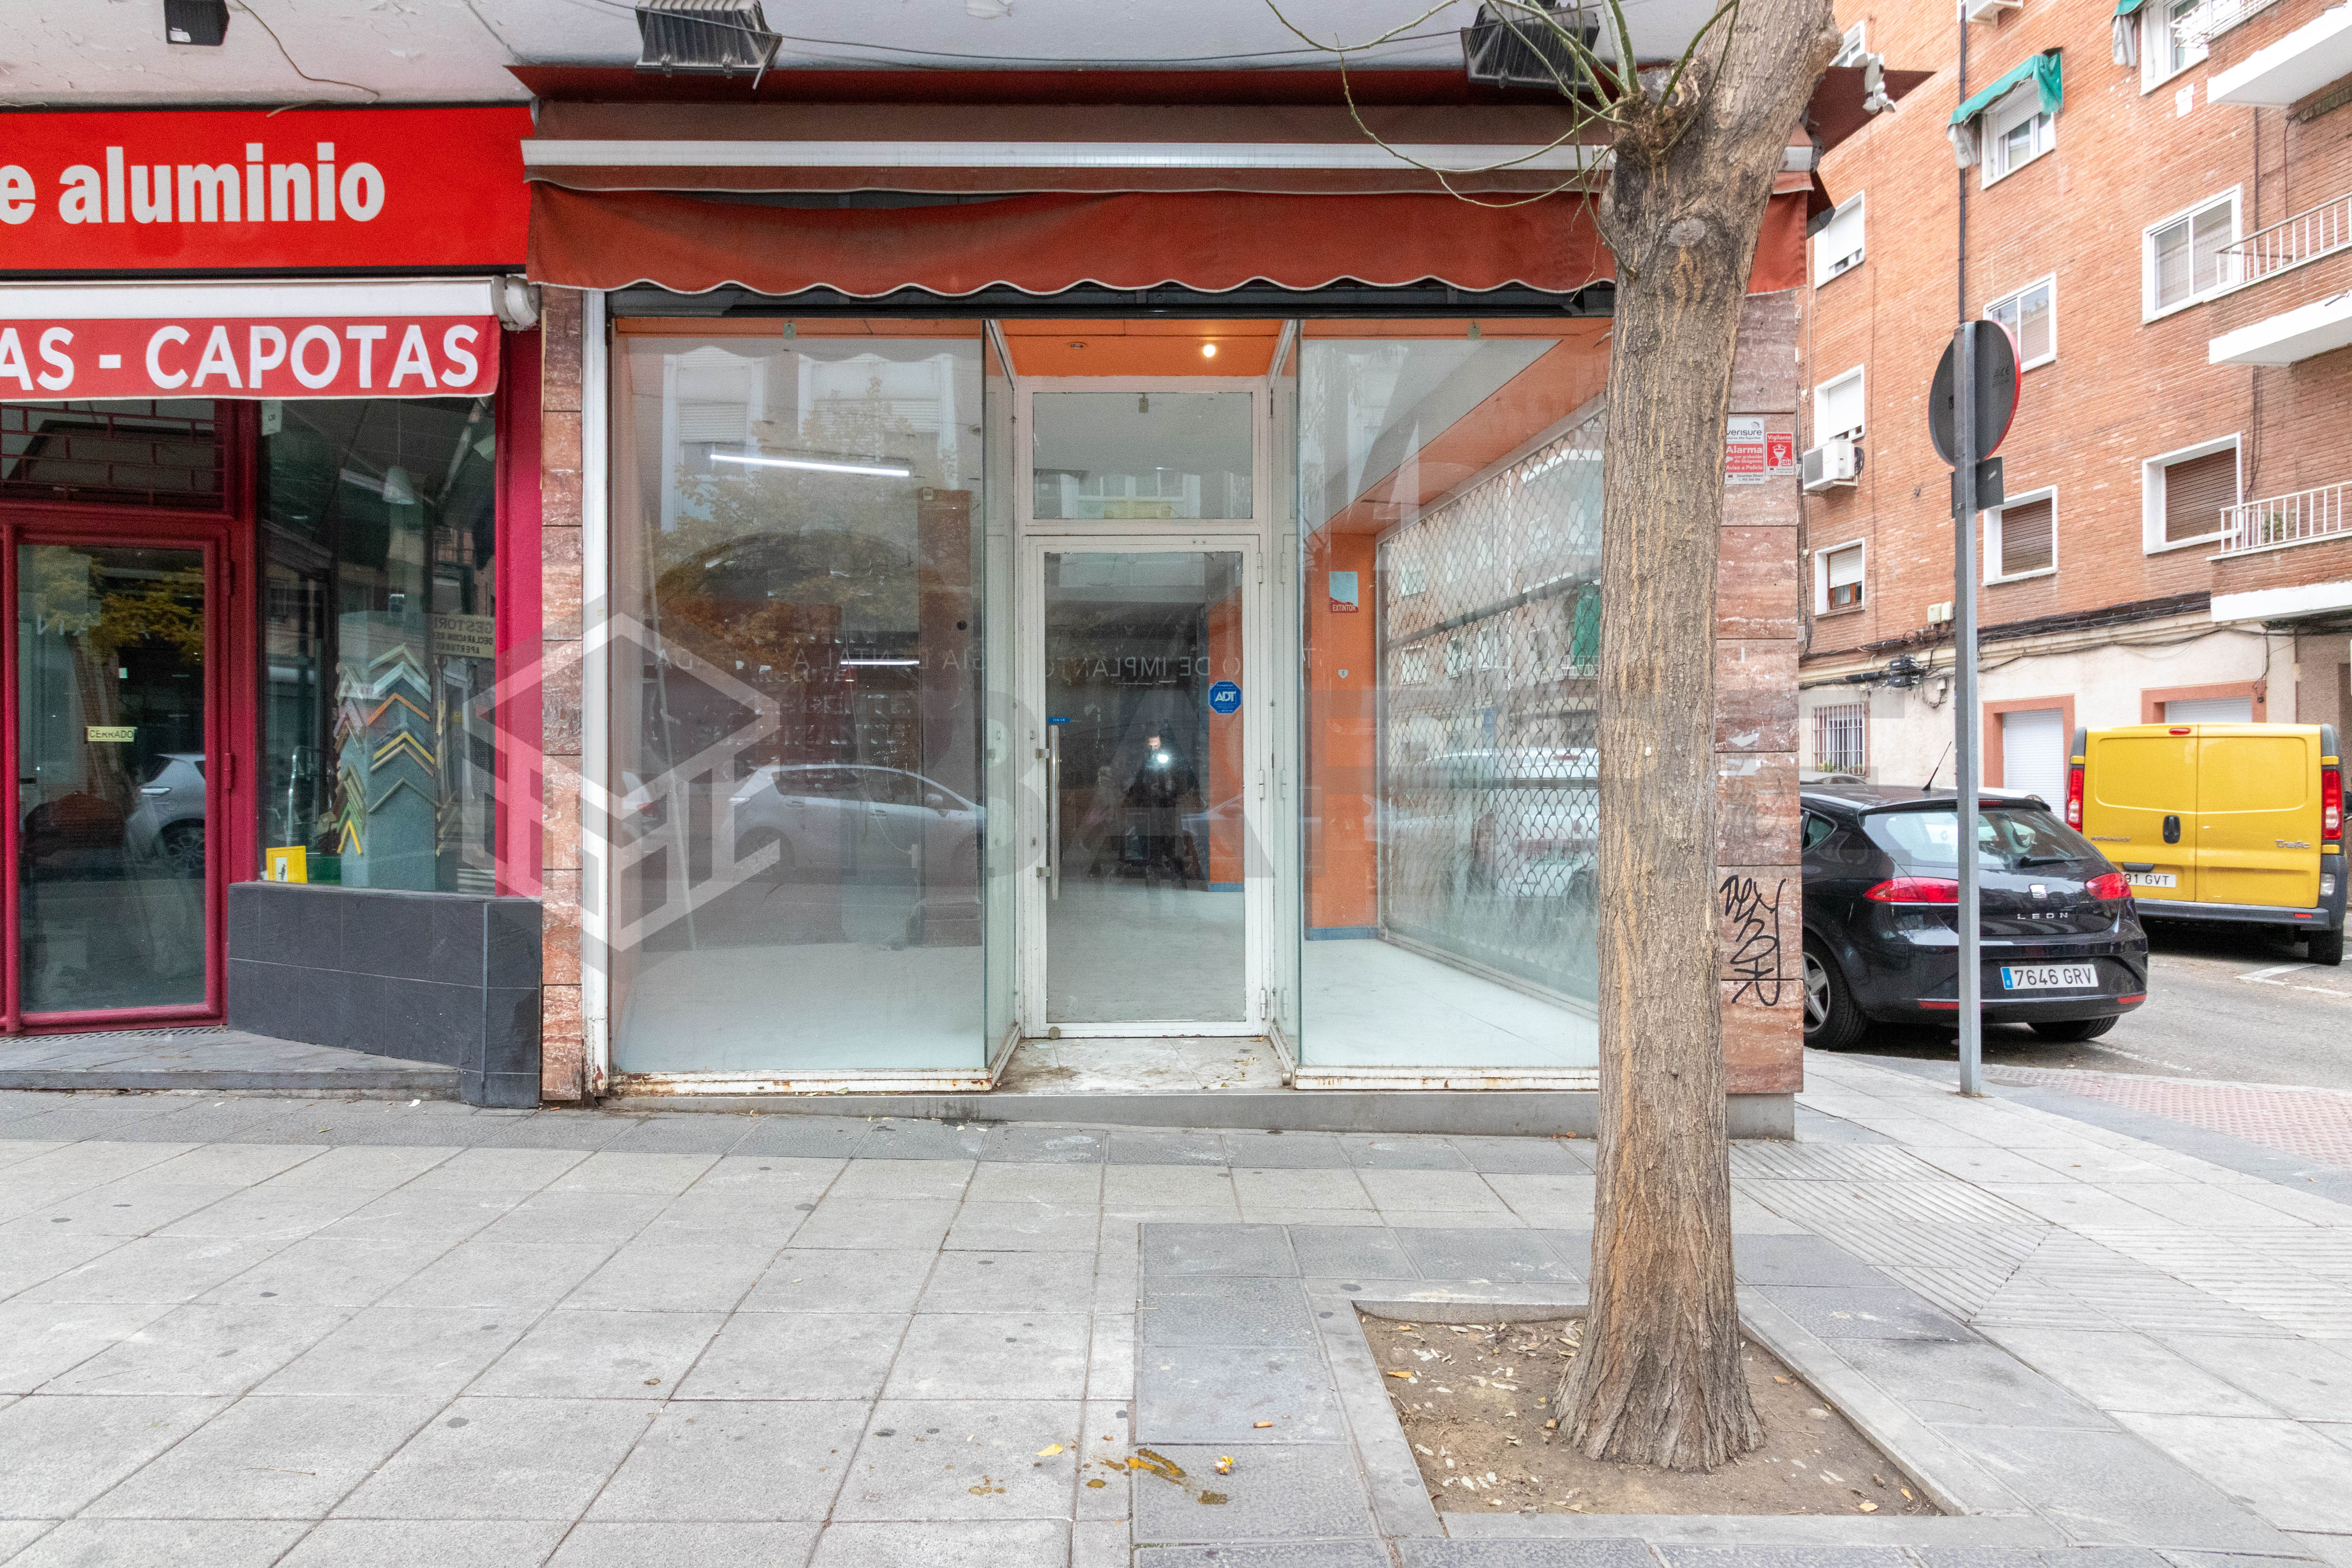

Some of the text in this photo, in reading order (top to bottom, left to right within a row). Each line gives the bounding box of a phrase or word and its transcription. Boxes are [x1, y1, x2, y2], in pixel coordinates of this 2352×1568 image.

[59, 142, 385, 223] aluminio
[146, 324, 479, 389] CAPOTAS
[1726, 445, 1763, 454] Alarma
[1214, 691, 1236, 702] ADT
[90, 730, 132, 738] CERRADO
[2145, 875, 2170, 886] GVT
[2014, 969, 2058, 986] 7646
[2063, 968, 2091, 985] GRV
